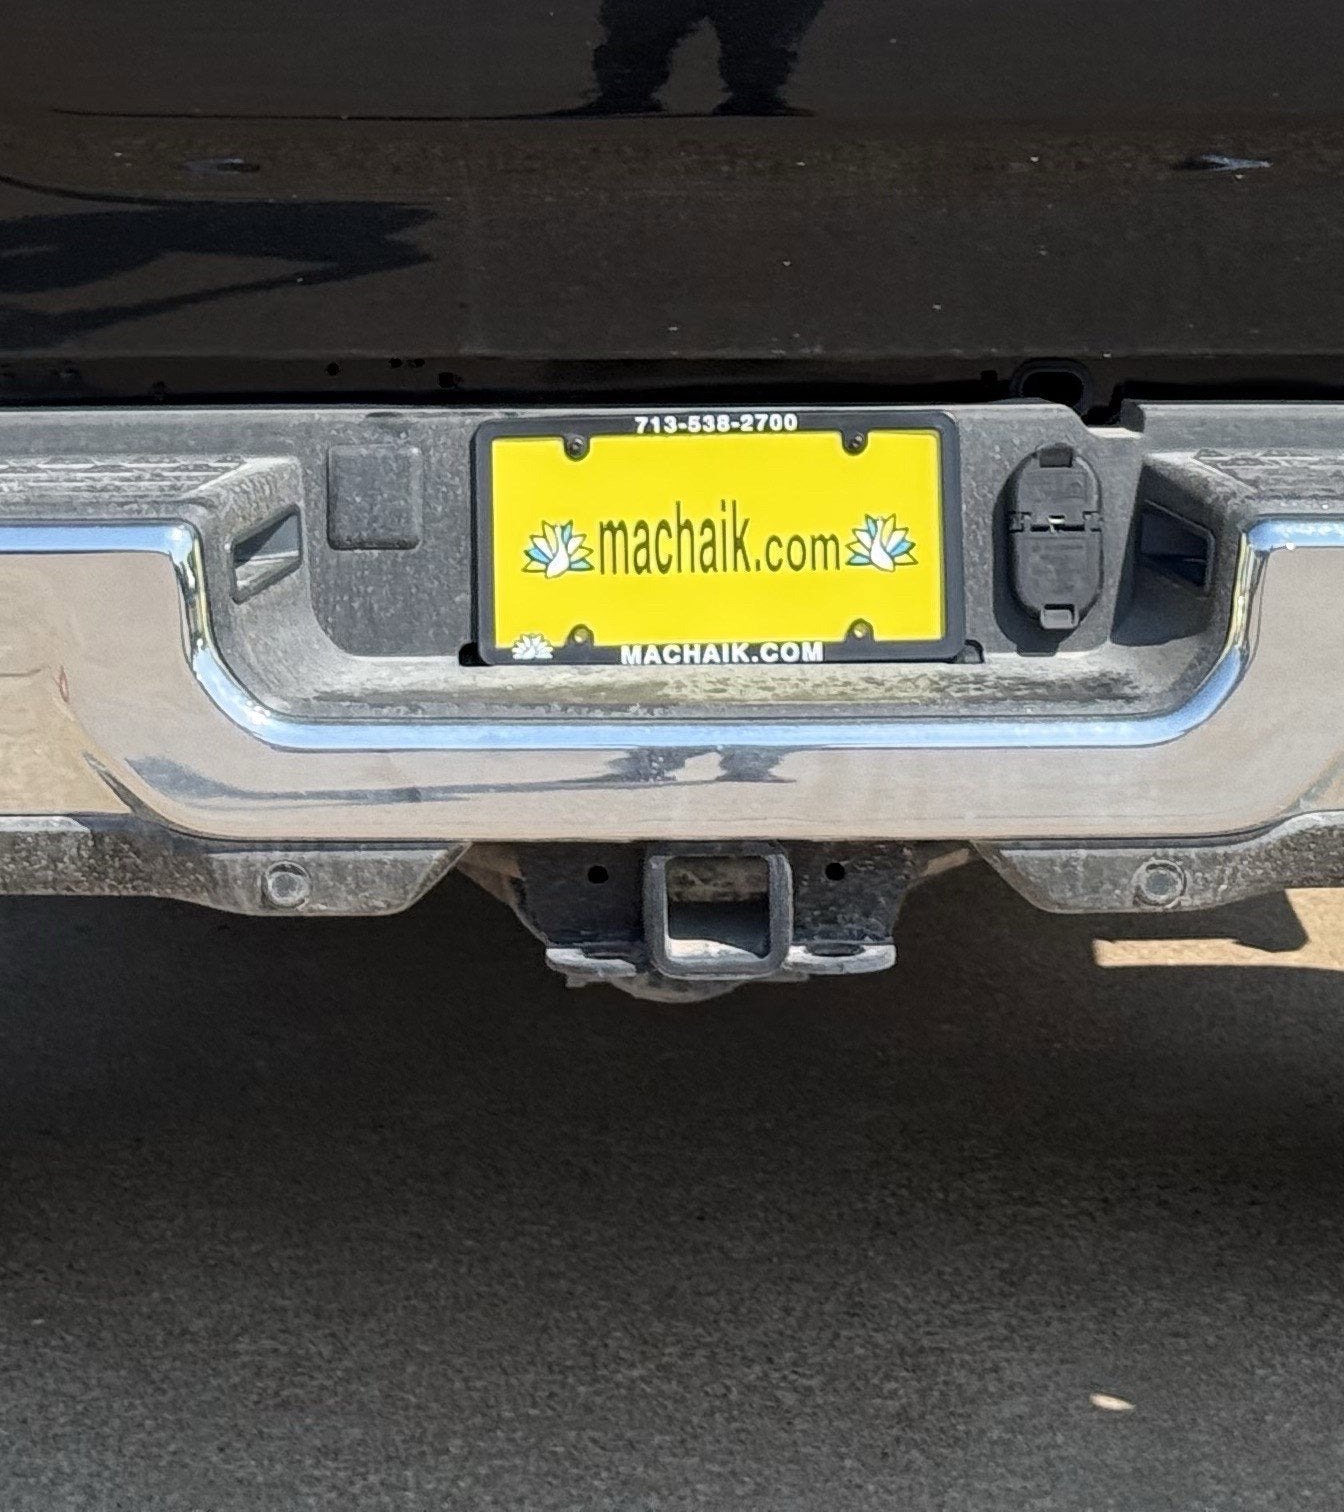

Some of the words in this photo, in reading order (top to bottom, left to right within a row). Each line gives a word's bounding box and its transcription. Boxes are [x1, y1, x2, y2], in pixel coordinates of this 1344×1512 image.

[634, 413, 798, 434] 713-538-2700
[599, 500, 841, 575] machaik.com
[620, 641, 824, 665] MACHAIK.COM
